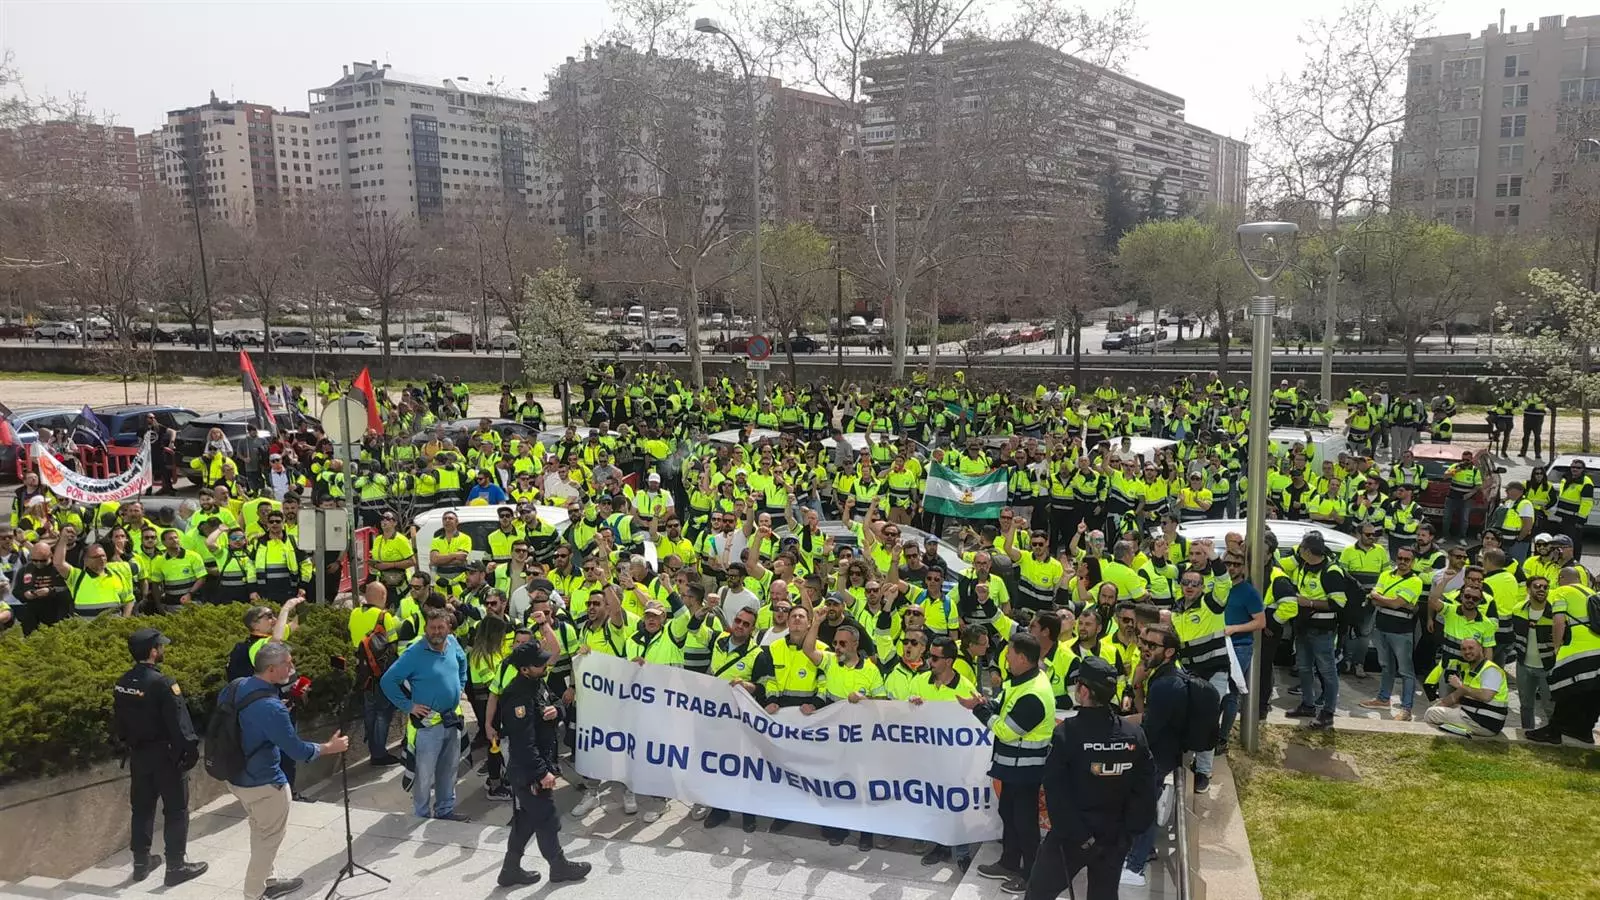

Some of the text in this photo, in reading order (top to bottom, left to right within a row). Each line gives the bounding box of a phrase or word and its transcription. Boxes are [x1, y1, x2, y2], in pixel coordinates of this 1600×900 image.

[582, 672, 992, 746] CON LOS TRABAJADORES DE ACERINOX
[1083, 742, 1130, 750] POLICIA
[646, 741, 690, 769] UN
[701, 750, 857, 800] CONVENIO
[868, 779, 991, 812] DIGNO!!
[1102, 762, 1133, 775] UIP
